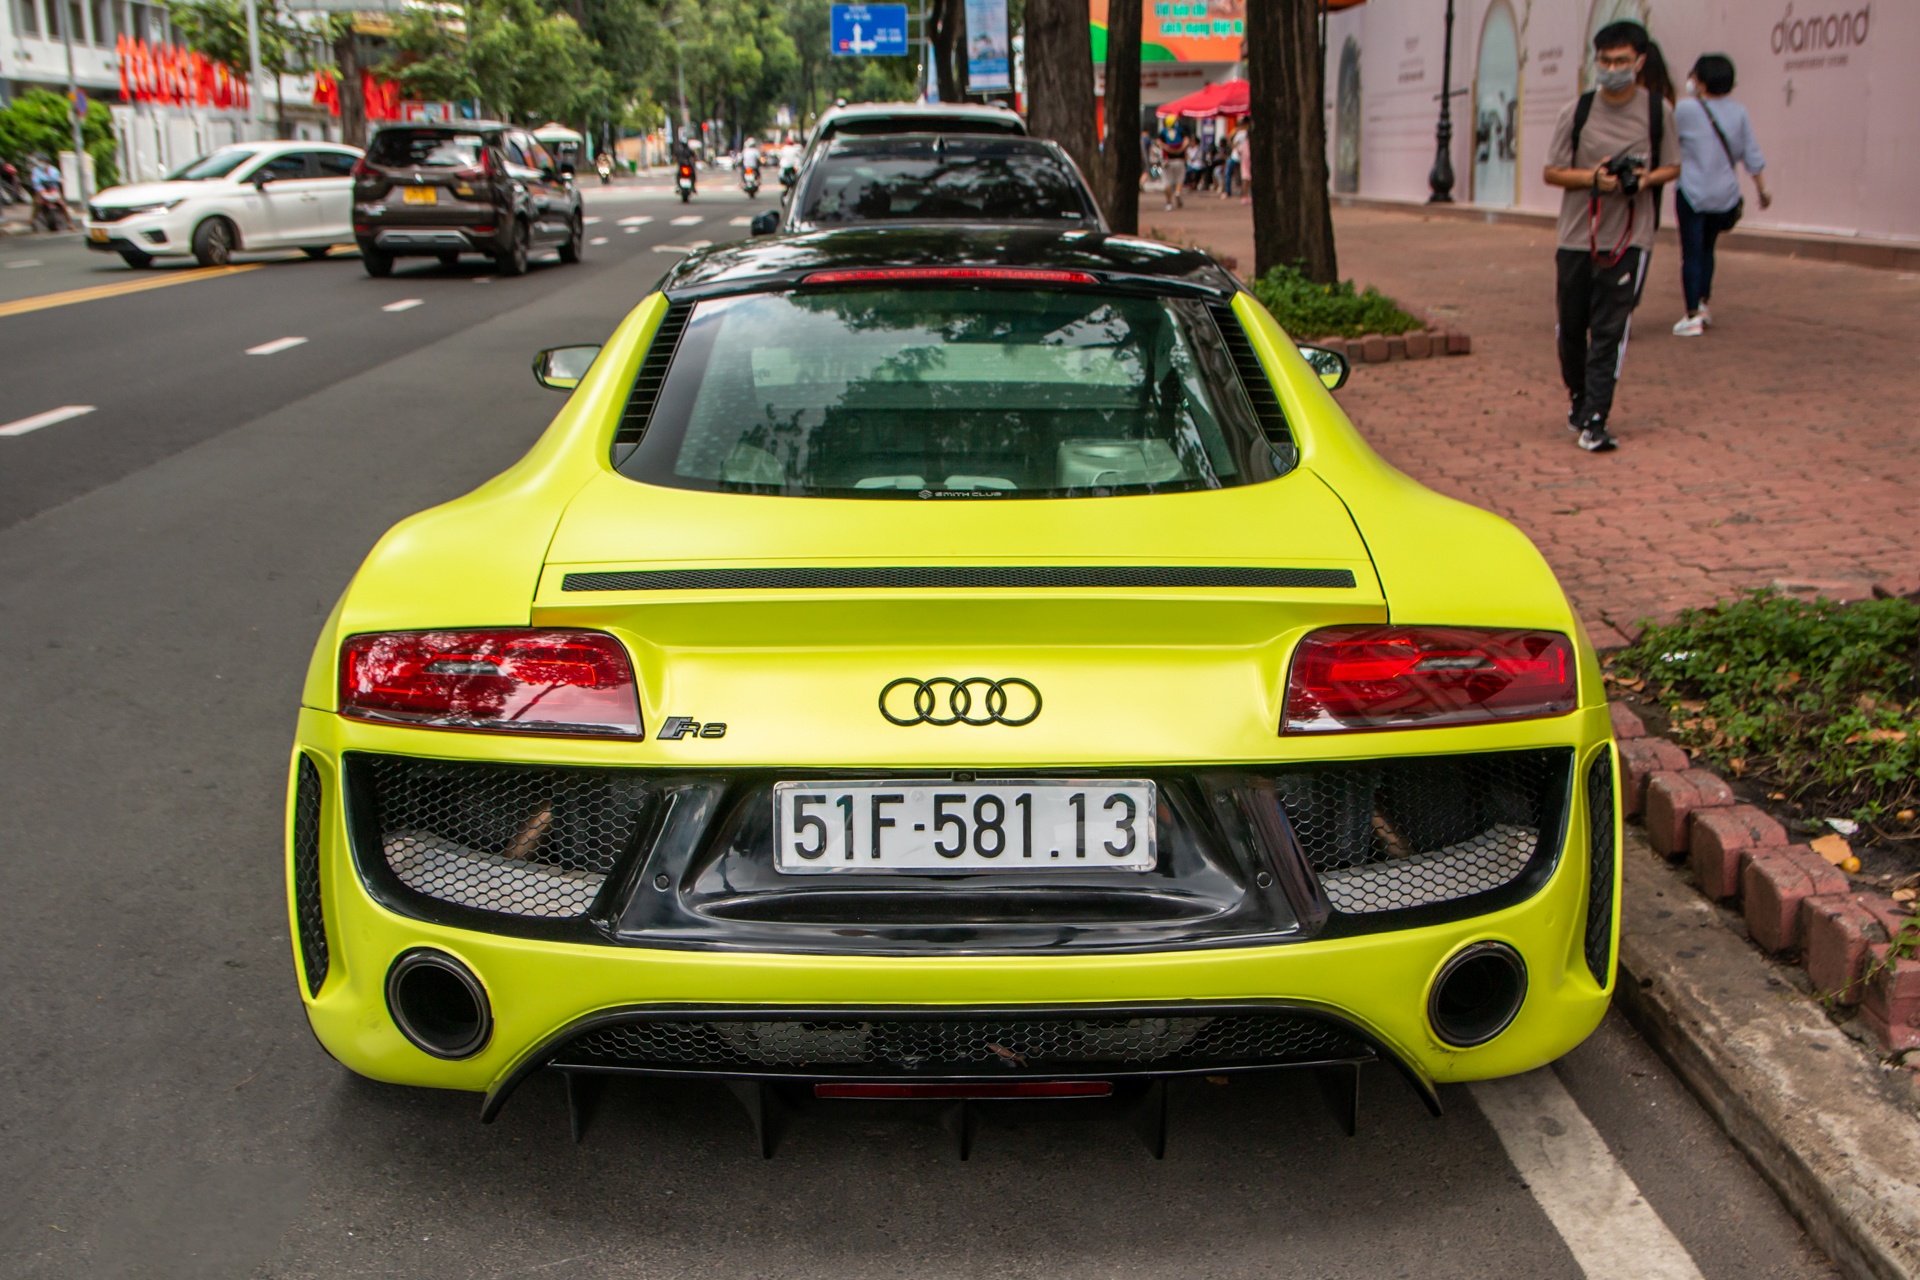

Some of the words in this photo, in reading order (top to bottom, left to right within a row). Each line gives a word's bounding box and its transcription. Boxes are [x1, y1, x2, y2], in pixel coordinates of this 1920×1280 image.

[1771, 0, 1871, 54] diamond
[671, 720, 728, 740] R8
[792, 792, 1138, 860] 51F-581.13
